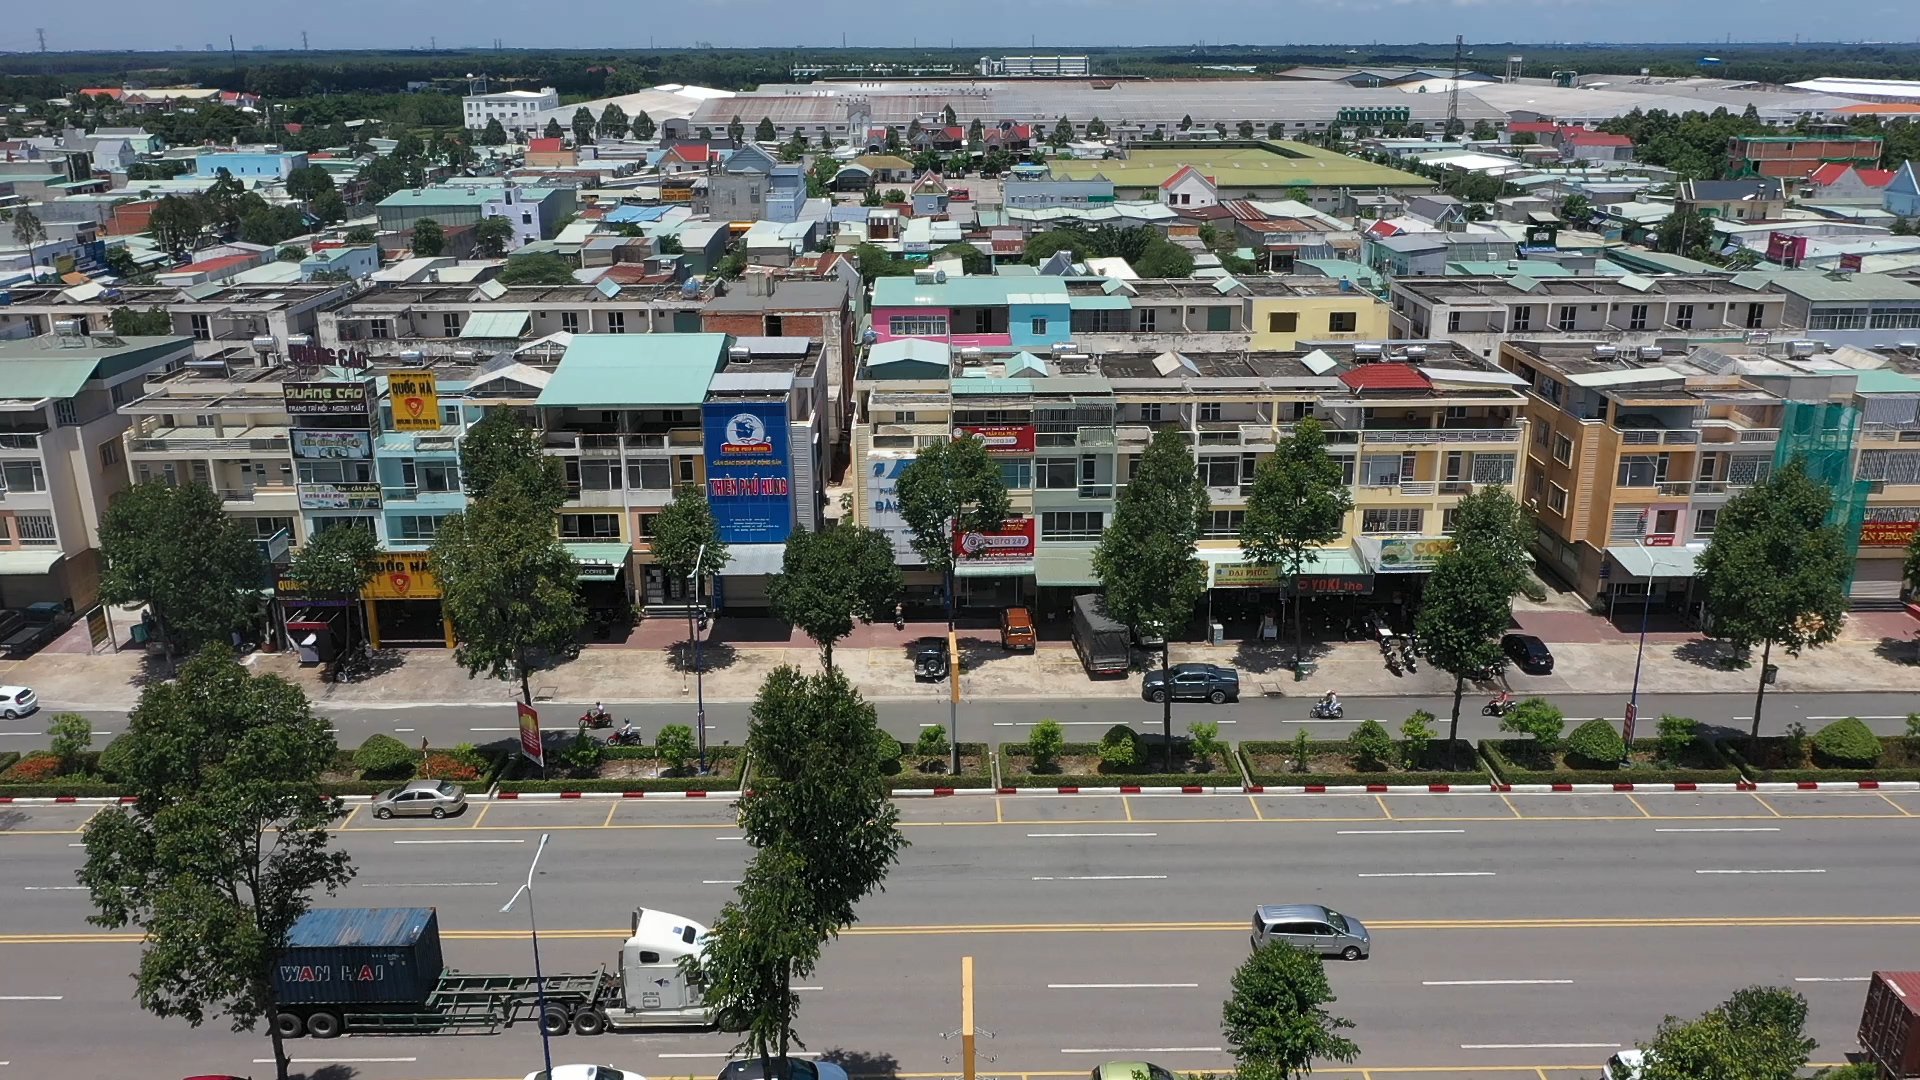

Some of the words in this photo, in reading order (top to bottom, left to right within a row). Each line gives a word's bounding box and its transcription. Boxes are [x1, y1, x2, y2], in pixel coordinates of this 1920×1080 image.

[286, 384, 332, 398] QUẢNG
[336, 384, 363, 398] CÁO
[392, 380, 416, 396] QUỐC
[419, 380, 432, 396] HÀ
[1012, 536, 1027, 544] 247
[1861, 530, 1876, 540] ĂN
[280, 965, 331, 982] WAN
[341, 965, 384, 982] HAI
